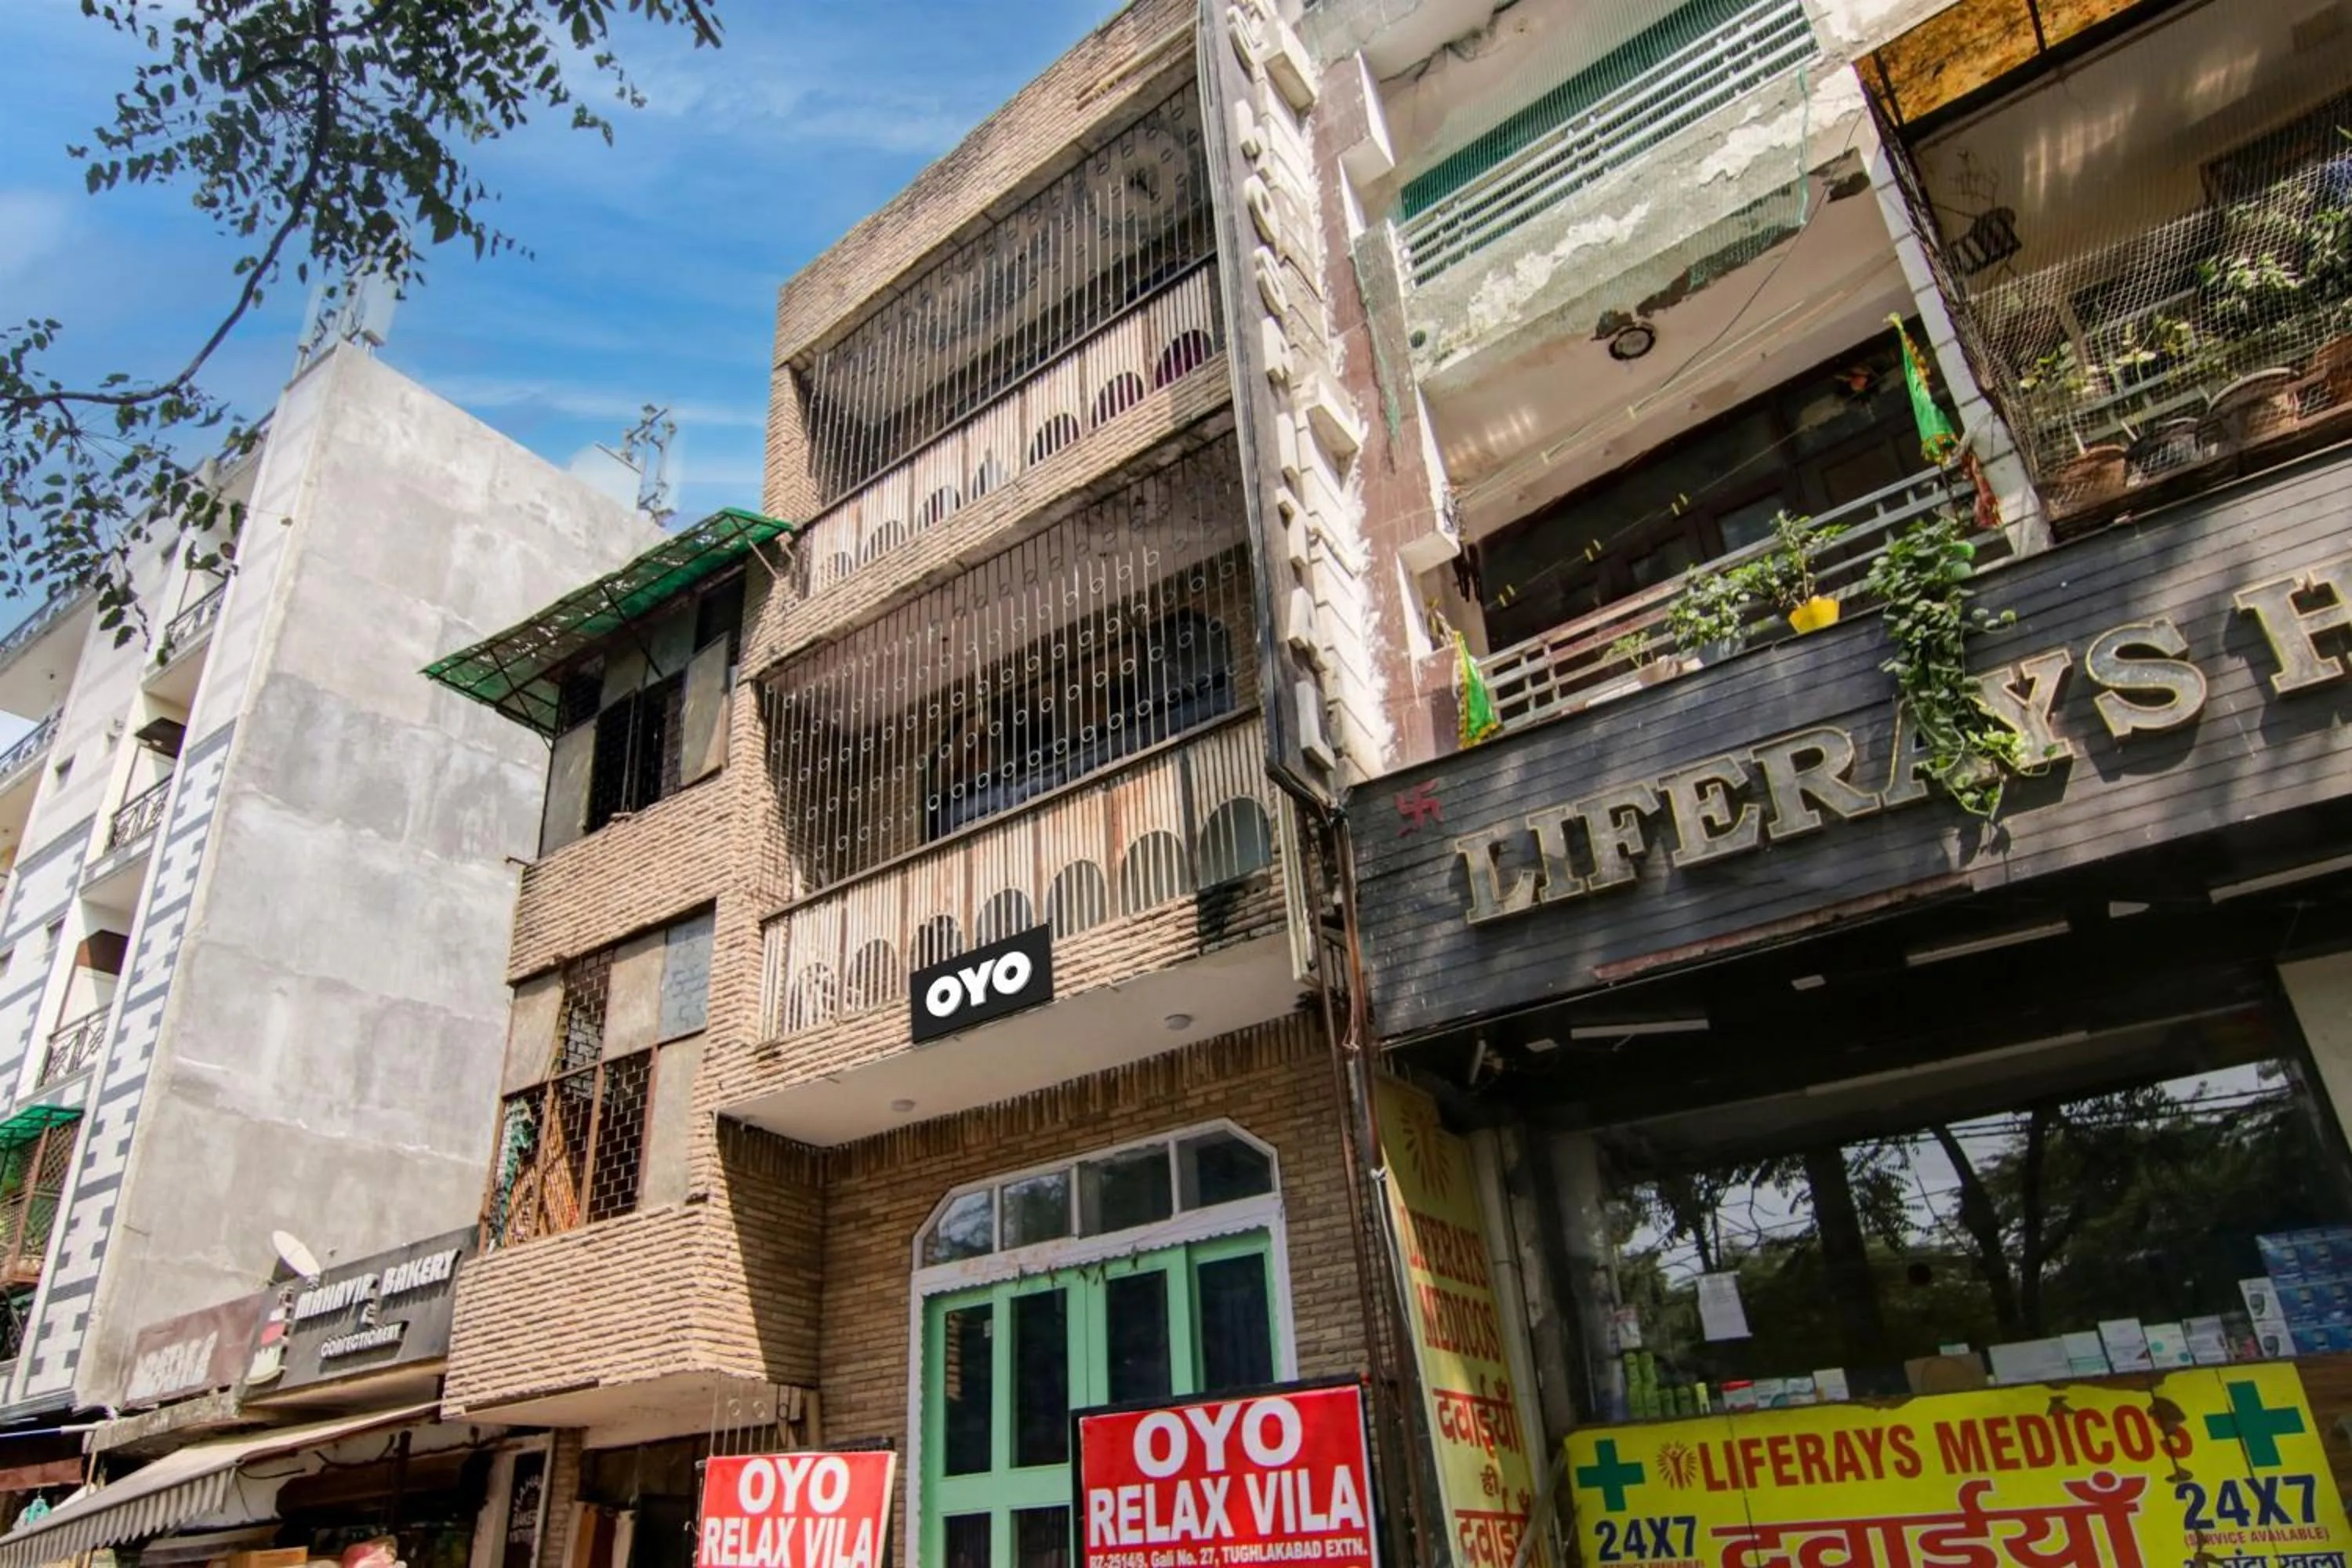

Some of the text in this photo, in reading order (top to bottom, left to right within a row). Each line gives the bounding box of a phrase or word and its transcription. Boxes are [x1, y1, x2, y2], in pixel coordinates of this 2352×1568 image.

[926, 951, 1033, 1018] OYO
[1400, 1205, 1491, 1290] LIFERAYS
[294, 1248, 461, 1319] MAHAVIR BAKERY
[1417, 1283, 1501, 1363] MEDICOS
[1134, 1396, 1302, 1478] OYO
[1698, 1404, 2193, 1492] LIFERAYS MEDICOS
[738, 1457, 850, 1514] OYO
[1089, 1465, 1365, 1548] RELAX VILA
[2175, 1473, 2316, 1530] 24X7
[701, 1516, 873, 1568] RELAX VILA
[1151, 1549, 1174, 1568] Gali
[1177, 1548, 1198, 1566] No.
[1221, 1540, 1323, 1564] TUGHLAKABAD
[1324, 1536, 1368, 1558] EXTN.
[1595, 1515, 1697, 1562] 24X7
[2183, 1526, 2331, 1549] (SRVICE AVAILABLE)
